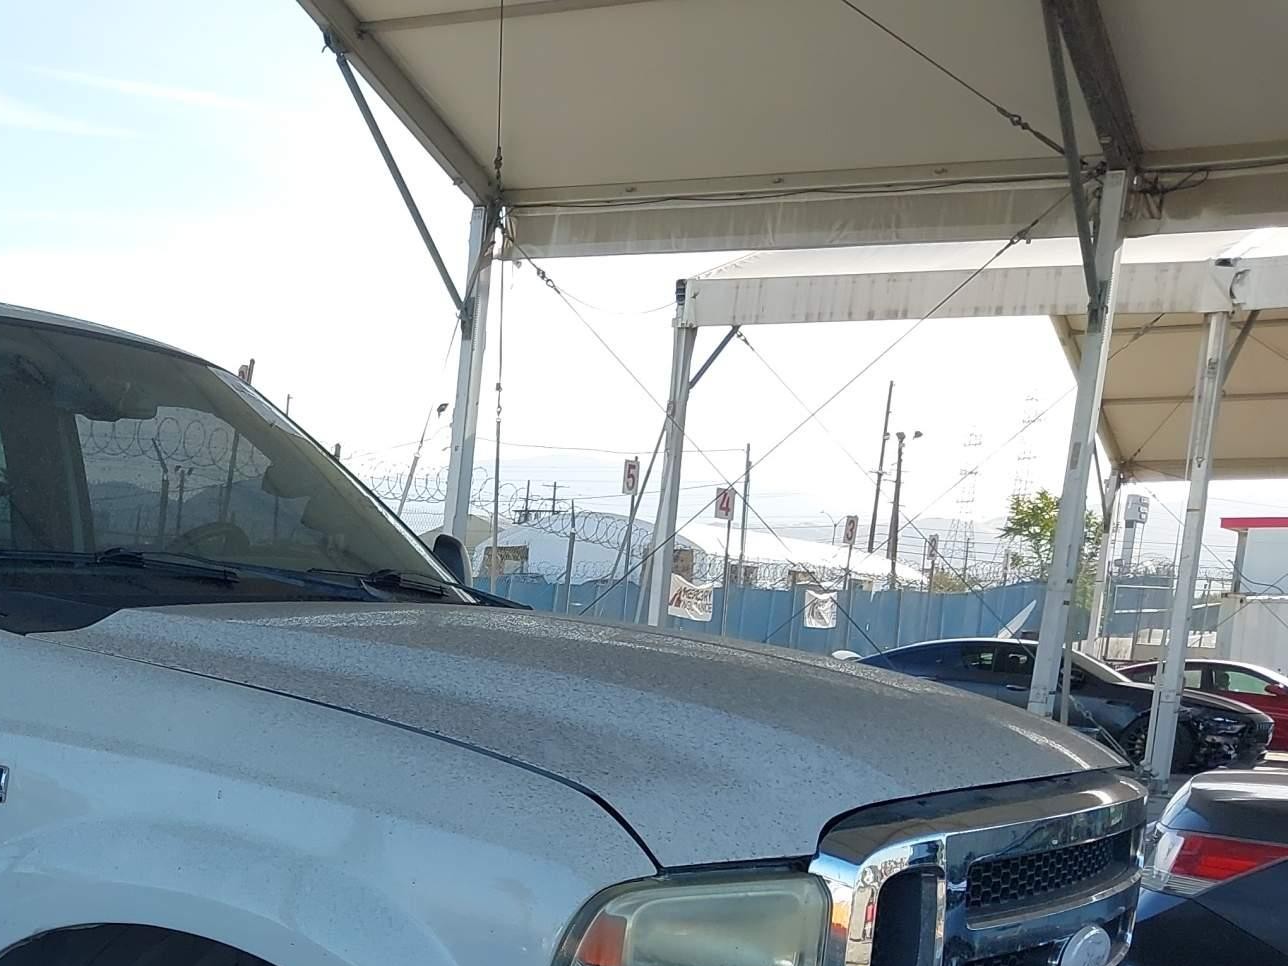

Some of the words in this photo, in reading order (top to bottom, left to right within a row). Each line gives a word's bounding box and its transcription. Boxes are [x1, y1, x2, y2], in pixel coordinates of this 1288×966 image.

[625, 464, 636, 491] 5
[719, 491, 731, 516] 4
[845, 519, 856, 541] 3
